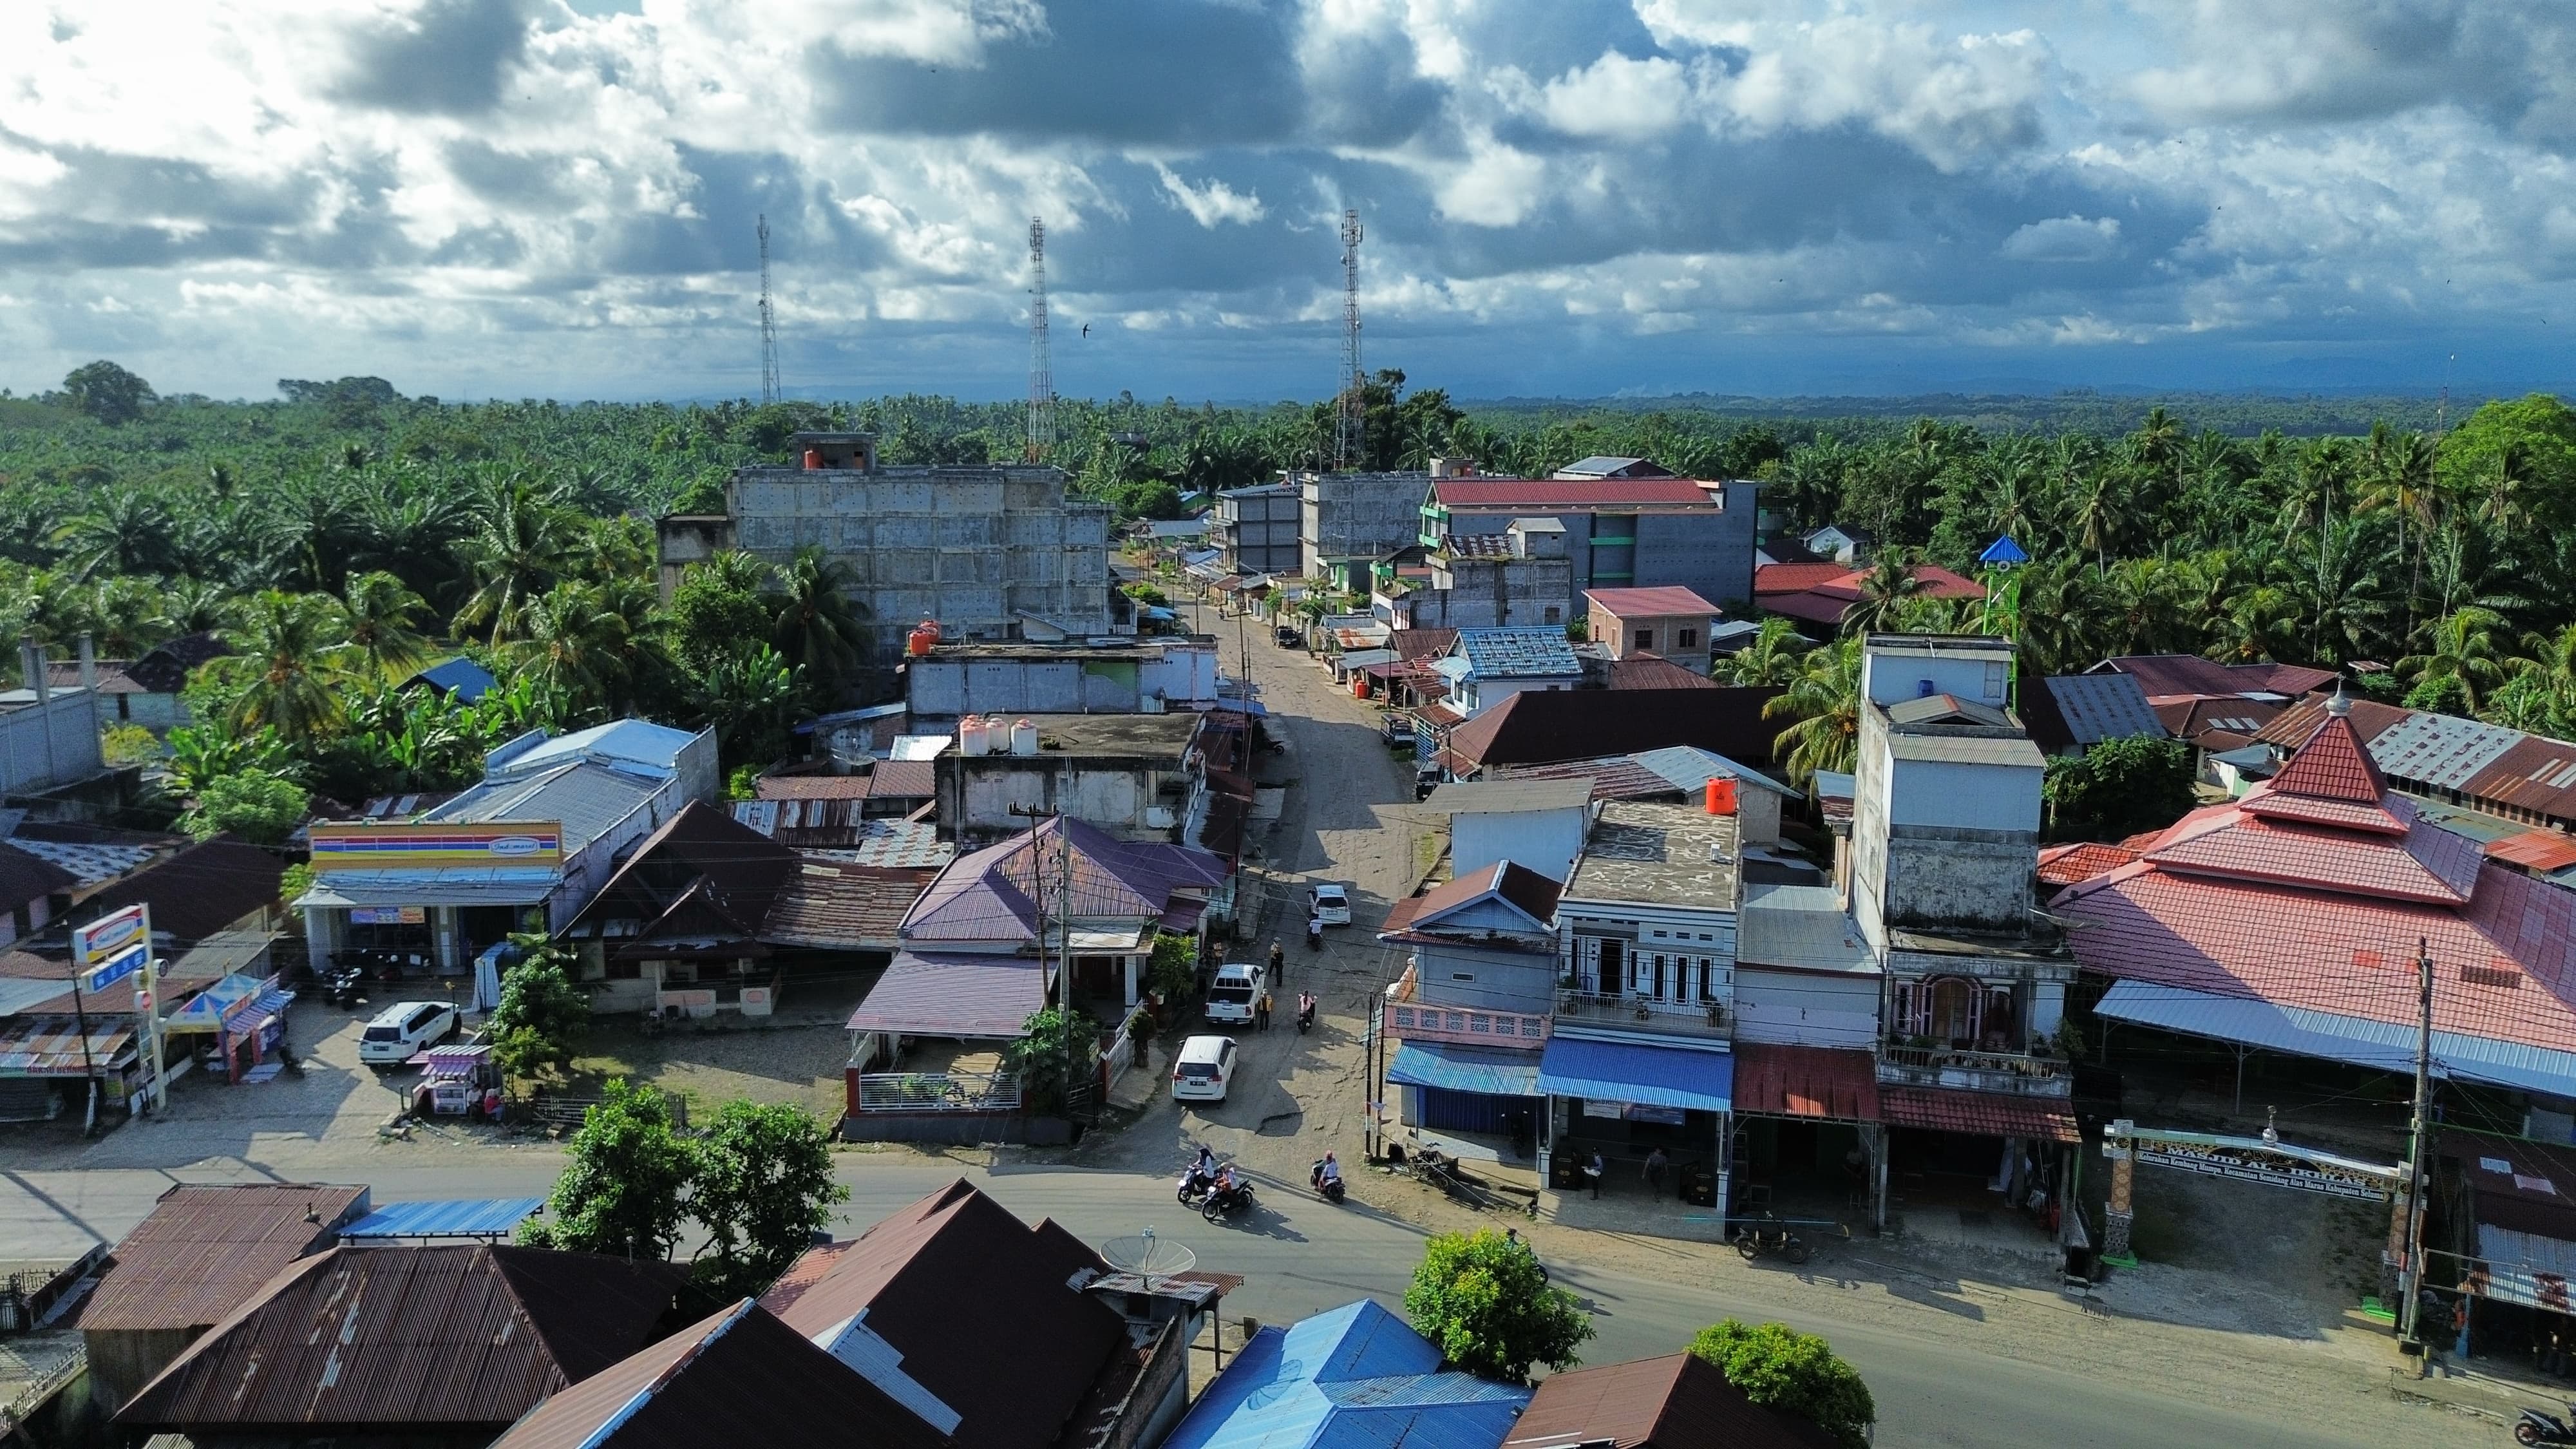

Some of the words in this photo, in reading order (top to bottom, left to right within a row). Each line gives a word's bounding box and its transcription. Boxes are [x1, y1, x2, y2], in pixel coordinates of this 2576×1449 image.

[97, 923, 133, 943] Indmaret
[2139, 1152, 2169, 1164] Kelurahan
[2170, 1157, 2198, 1171] Kembang
[2224, 1168, 2258, 1180] Kecamatan
[2259, 1173, 2289, 1186] Semidang
[2289, 1178, 2304, 1188] Alas
[2304, 1180, 2325, 1191] Maras
[2325, 1183, 2359, 1197] Kabupaten
[2360, 1189, 2384, 1200] Seluma
[2167, 1148, 2242, 1165] MASJID
[2246, 1161, 2271, 1171] AL
[2290, 1168, 2366, 1186] IKHLAS
